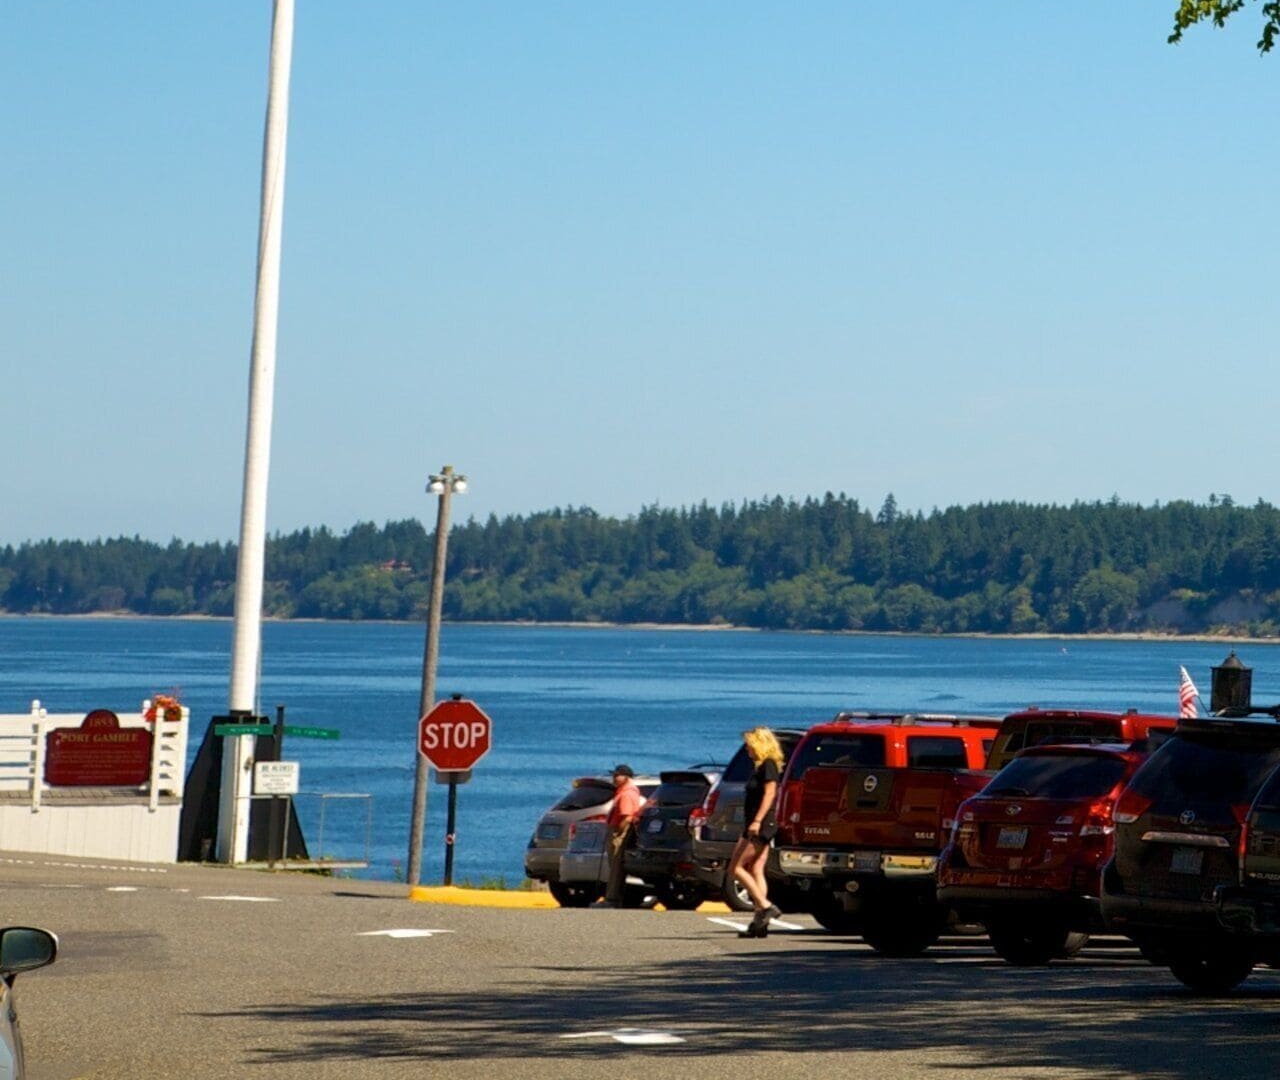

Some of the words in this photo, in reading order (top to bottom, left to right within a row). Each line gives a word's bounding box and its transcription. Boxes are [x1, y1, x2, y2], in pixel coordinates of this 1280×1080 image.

[92, 733, 139, 743] GAMBLE
[424, 722, 487, 749] STOP
[803, 826, 831, 836] TITAN
